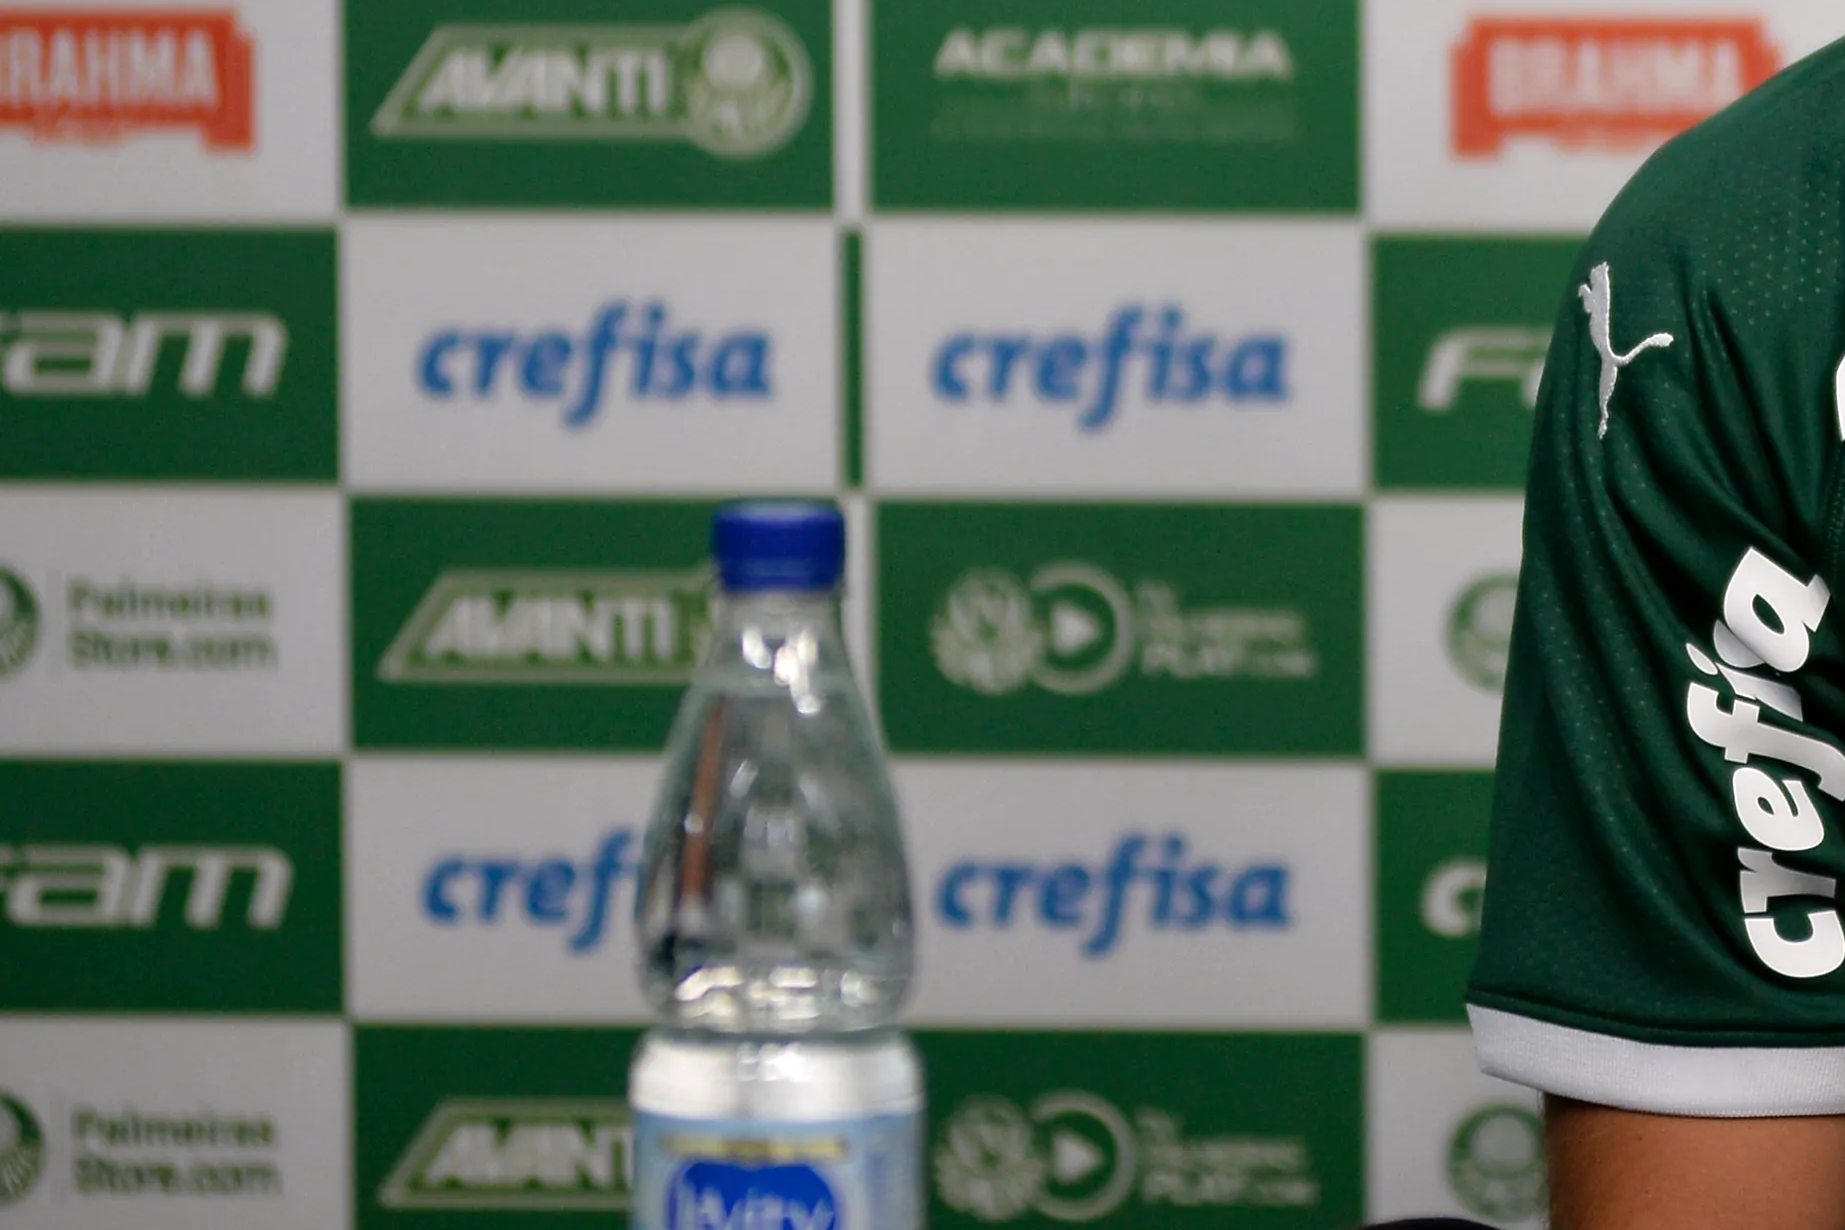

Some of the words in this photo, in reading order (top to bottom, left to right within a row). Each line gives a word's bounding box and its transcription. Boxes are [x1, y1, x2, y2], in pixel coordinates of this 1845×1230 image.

[0, 27, 219, 108] RAHMA
[417, 48, 669, 112] AVANTI
[935, 28, 1293, 81] ACADEMIA
[0, 314, 286, 395] am
[416, 302, 771, 428] crefisa
[931, 305, 1289, 433] crefisa
[420, 594, 673, 660] AVANTI
[0, 847, 292, 927] am
[421, 830, 640, 954] cref
[934, 833, 1291, 960] crefisa
